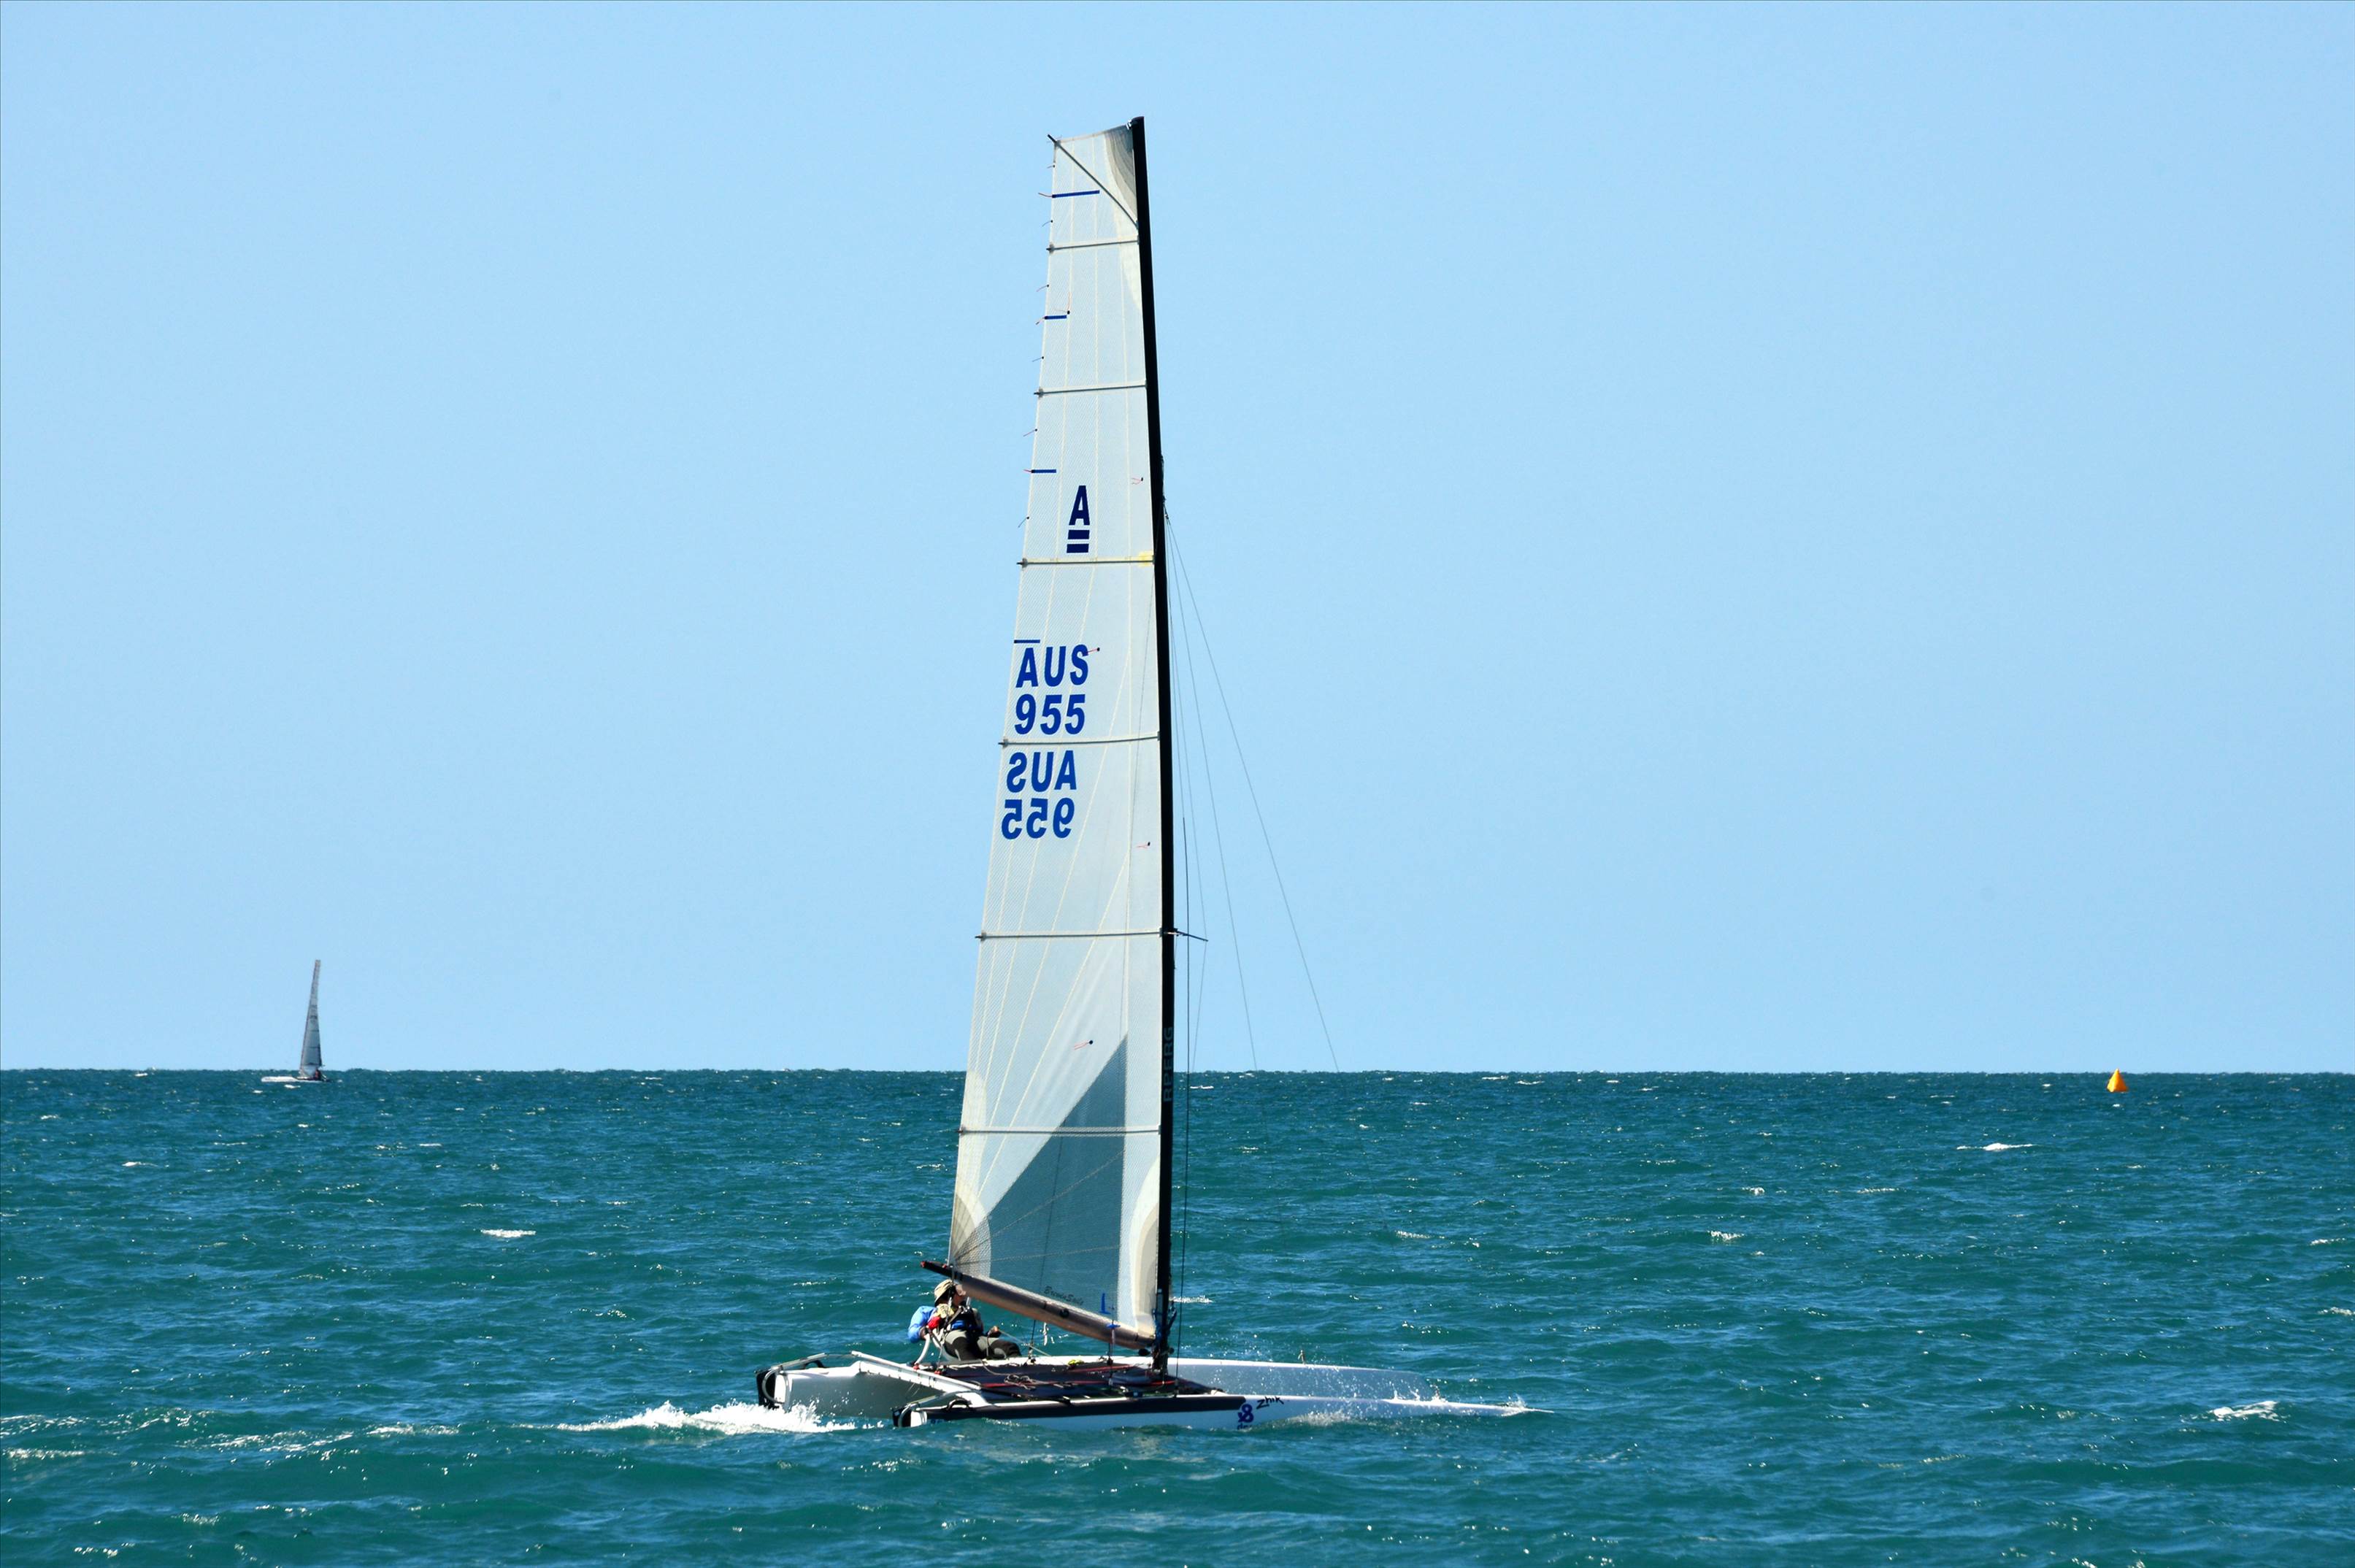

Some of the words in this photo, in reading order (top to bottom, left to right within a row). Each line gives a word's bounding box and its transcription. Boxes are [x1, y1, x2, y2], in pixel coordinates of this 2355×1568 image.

[1069, 485, 1090, 526] A
[1016, 644, 1088, 688] AUS
[1015, 694, 1085, 735] 955
